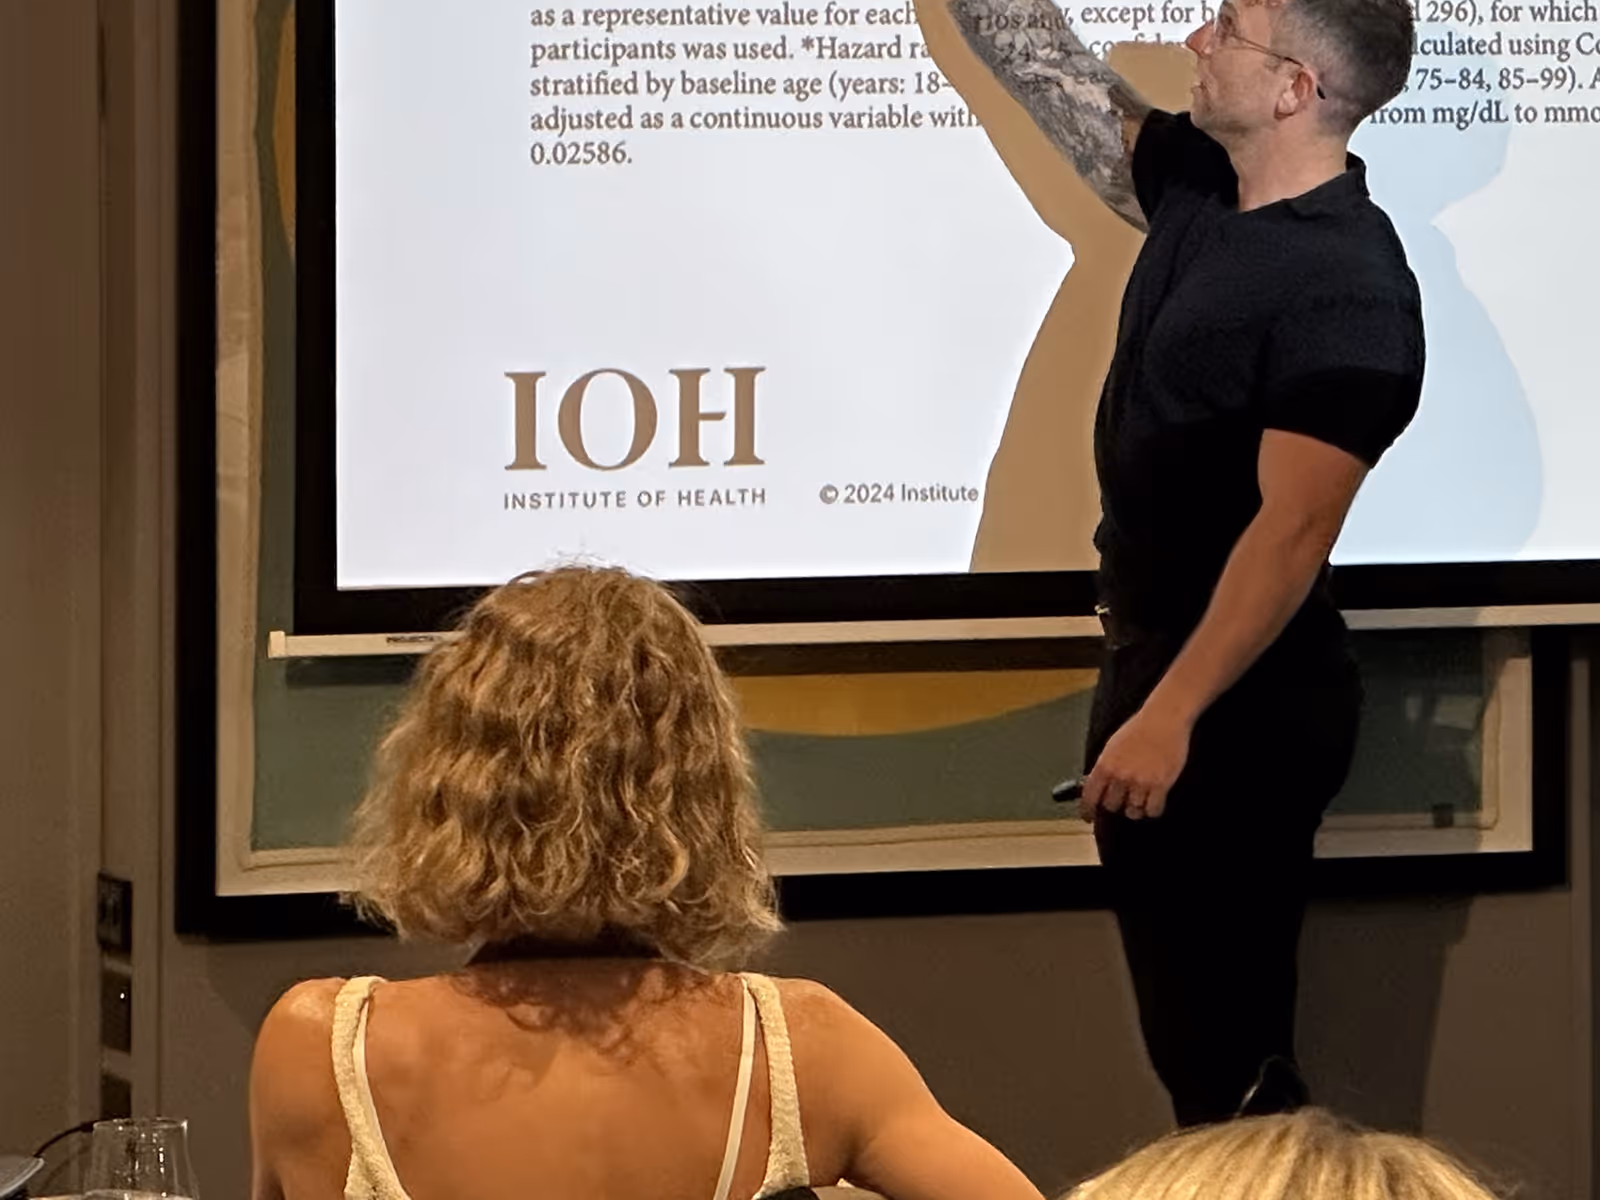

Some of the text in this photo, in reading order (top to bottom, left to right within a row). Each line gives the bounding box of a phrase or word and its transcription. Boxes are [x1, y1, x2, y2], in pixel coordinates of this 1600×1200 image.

[531, 37, 676, 68] participants
[682, 41, 726, 60] was
[733, 34, 794, 60] used.
[1412, 29, 1502, 56] lculated
[1509, 33, 1570, 63] using
[531, 104, 633, 137] adjusted
[641, 112, 663, 130] as
[671, 112, 684, 129] a
[690, 106, 823, 129] continuous
[829, 104, 923, 129] variable
[1433, 99, 1509, 132] mg/dL
[1515, 103, 1537, 123] to
[530, 140, 632, 165] 0.02586.
[504, 366, 766, 472] IOH
[504, 488, 765, 510] INSTITUTE OF HEALTH
[844, 483, 894, 504] 2024
[902, 483, 978, 502] Institute
